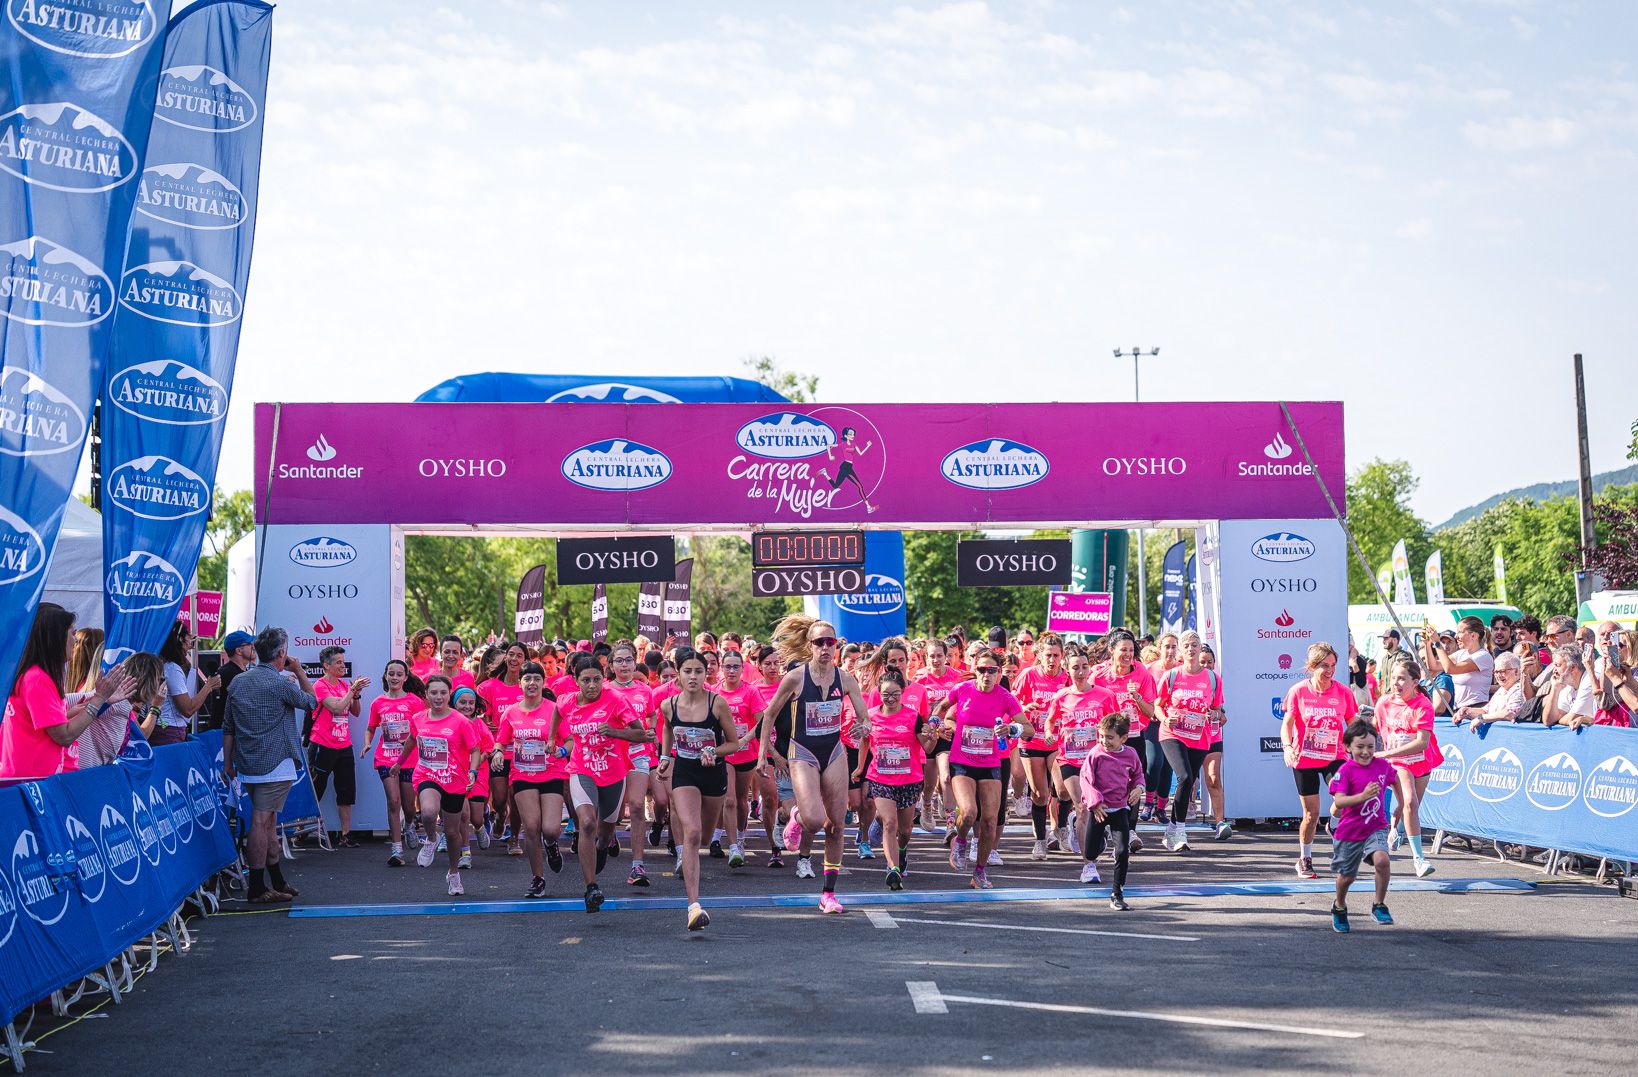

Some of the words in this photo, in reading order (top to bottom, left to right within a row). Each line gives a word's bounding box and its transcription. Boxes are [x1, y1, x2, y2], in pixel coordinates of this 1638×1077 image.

[16, 0, 142, 41] ASTURIANA
[20, 124, 71, 142] CENTRAL
[75, 135, 120, 152] LECHERA
[0, 124, 122, 178] ASTURIANA
[154, 180, 196, 193] CENTRAL
[138, 179, 240, 220] ASTURIANA
[44, 270, 101, 289] LECHERA
[144, 278, 187, 289] CENTRAL
[0, 276, 102, 315] STURIANA
[124, 277, 234, 317] ASTURIANA
[117, 378, 220, 416] ASTURIANA
[137, 379, 176, 389] CENTRAL
[179, 384, 219, 397] LECHERA
[0, 407, 69, 444] RIANA
[744, 429, 829, 447] ASTURIANA
[278, 463, 363, 479] Santander
[418, 458, 507, 478] OYSHO
[570, 457, 664, 478] ASTURIANA
[728, 455, 810, 480] Carrera
[950, 457, 1041, 477] ASTURIANA
[1103, 456, 1187, 476] OYSHO
[1238, 461, 1319, 476] Santander
[113, 474, 200, 509] ASTURIANA
[747, 481, 763, 498] de
[766, 481, 778, 498] la
[775, 477, 841, 518] Mujer
[2, 533, 30, 546] HERA
[295, 548, 352, 560] ASTURIANA
[1256, 543, 1311, 555] ASTURIANA
[576, 550, 659, 570] OYSHO
[976, 554, 1057, 572] OYSHO
[758, 569, 861, 594] OYSHO
[1250, 578, 1317, 593] OYSHO
[288, 584, 358, 599] OYSHO
[520, 592, 542, 600] OYSHO
[1050, 610, 1109, 622] CORREDORAS
[1367, 613, 1425, 622] AMBUANCIA
[1608, 603, 1638, 615] AMBU
[294, 636, 353, 647] Santander
[1257, 629, 1313, 639] Santander
[1256, 672, 1288, 681] octopus
[928, 689, 949, 697] CARRER
[1181, 689, 1204, 698] ARRERA
[1305, 707, 1337, 717] CARRERA
[1429, 768, 1460, 783] STURIANA
[1469, 765, 1518, 790] ASTURIANA
[1529, 772, 1577, 797] ASTURIANA
[1586, 776, 1636, 803] ASTURIANA
[18, 870, 55, 905] ASTURI
